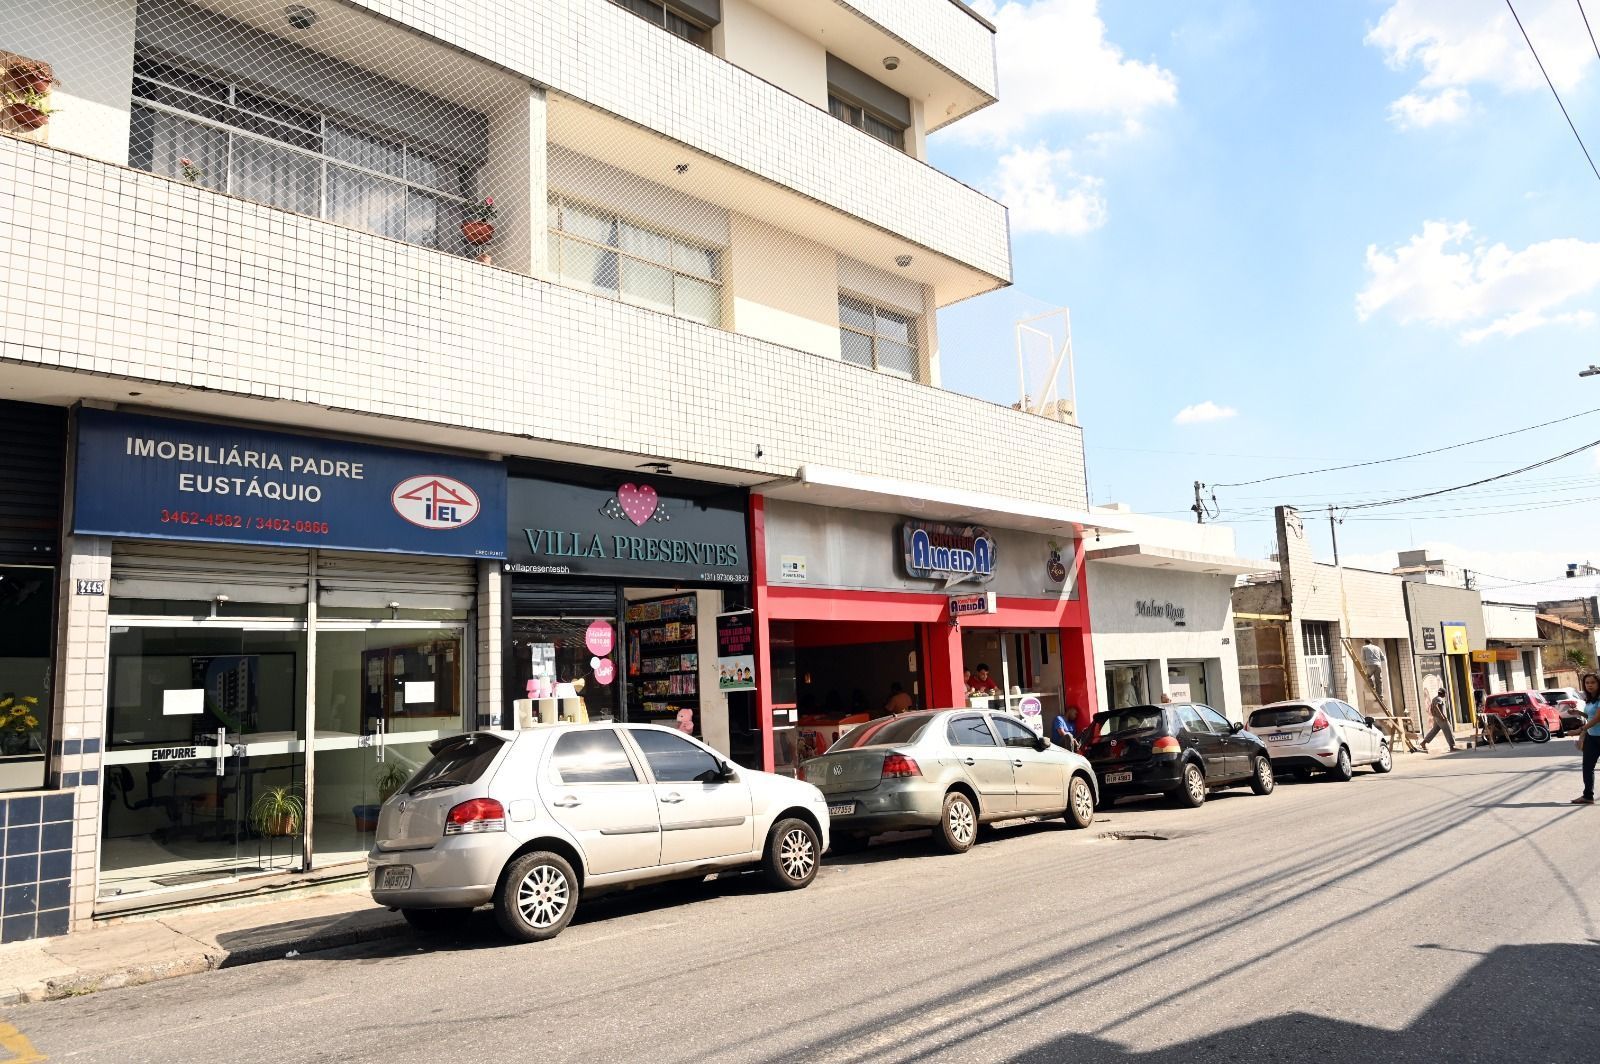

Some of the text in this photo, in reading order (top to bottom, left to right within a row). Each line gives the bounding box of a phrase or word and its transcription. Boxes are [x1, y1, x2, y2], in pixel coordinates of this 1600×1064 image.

[126, 437, 364, 480] IMOBILIÁRIA PADRE
[178, 474, 322, 503] EUSTÁQUIO
[160, 509, 243, 528] 3462-4582
[255, 517, 330, 534] 3462-0866
[523, 528, 739, 566] VILLA PRESENTES
[912, 529, 991, 574] ALMEIDA
[510, 563, 571, 574] villapresentesbh
[80, 581, 103, 593] 2443
[951, 597, 986, 613] ALMEIDA
[151, 747, 197, 761] EMPURRE
